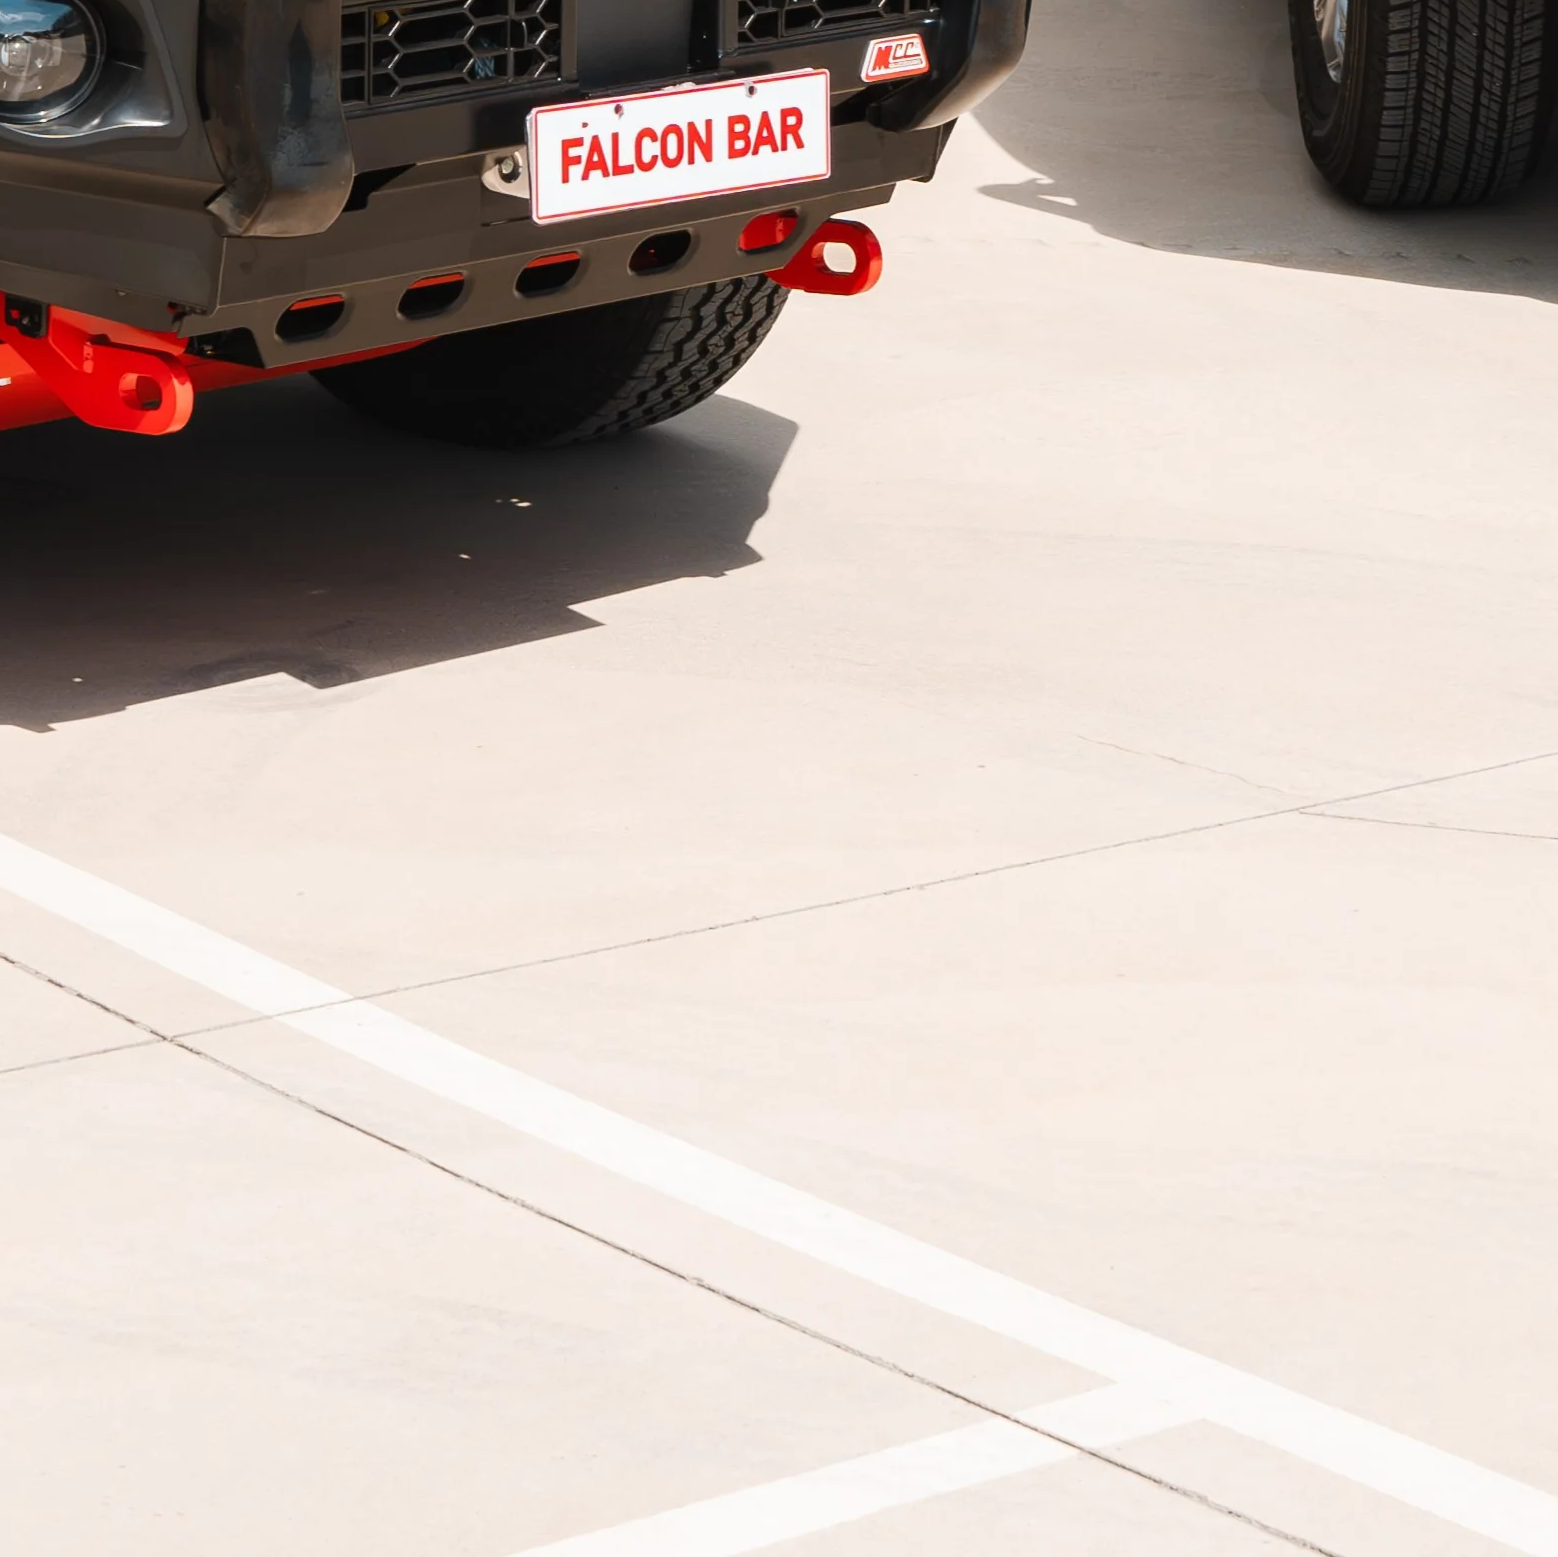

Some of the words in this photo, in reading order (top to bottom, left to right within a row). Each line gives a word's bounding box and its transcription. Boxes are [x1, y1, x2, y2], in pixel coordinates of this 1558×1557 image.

[871, 41, 922, 73] MCC
[560, 118, 714, 184] FALCON
[727, 106, 806, 159] BAR
